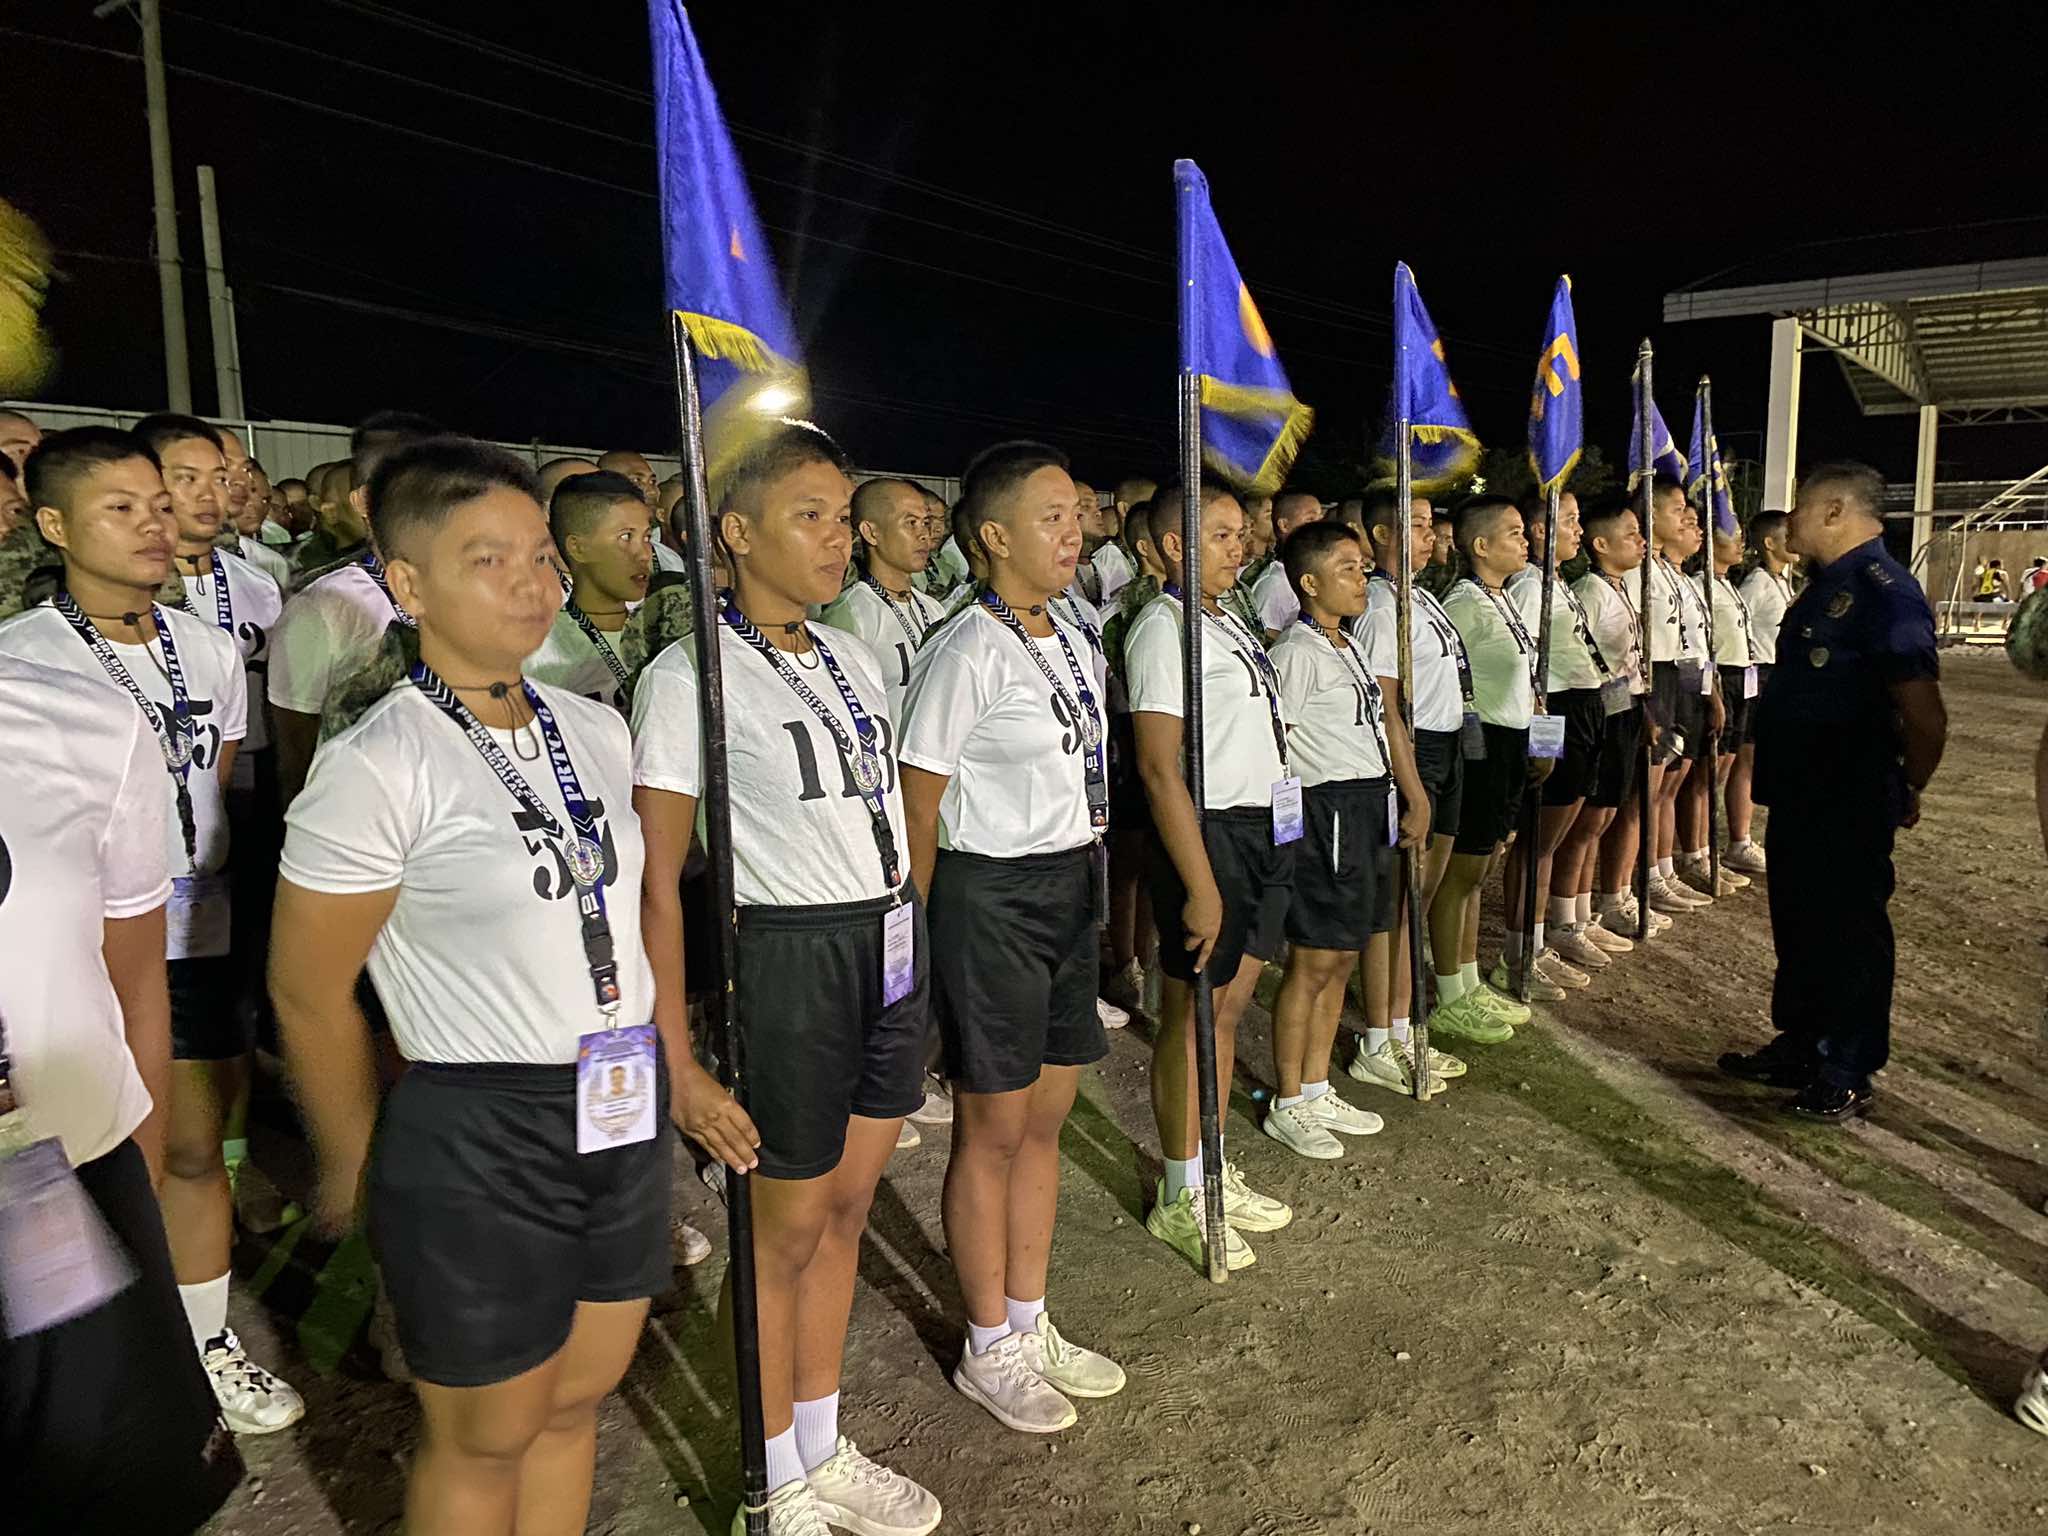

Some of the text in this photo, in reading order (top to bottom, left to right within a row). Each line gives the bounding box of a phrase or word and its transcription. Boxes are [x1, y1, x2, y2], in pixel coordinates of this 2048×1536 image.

[214, 580, 232, 624] PRTC
[109, 656, 136, 691] BATCH
[132, 689, 156, 718] 2024
[775, 663, 825, 720] MASIGTALAS
[828, 662, 867, 720] PRTC
[1062, 641, 1087, 692] PRTC
[796, 678, 826, 712] BATCH
[822, 710, 848, 739] 2024
[467, 728, 524, 798] MASIGTALAS
[489, 745, 528, 789] BATCH
[522, 787, 554, 823] 2024
[537, 706, 584, 803] PRTC 6
